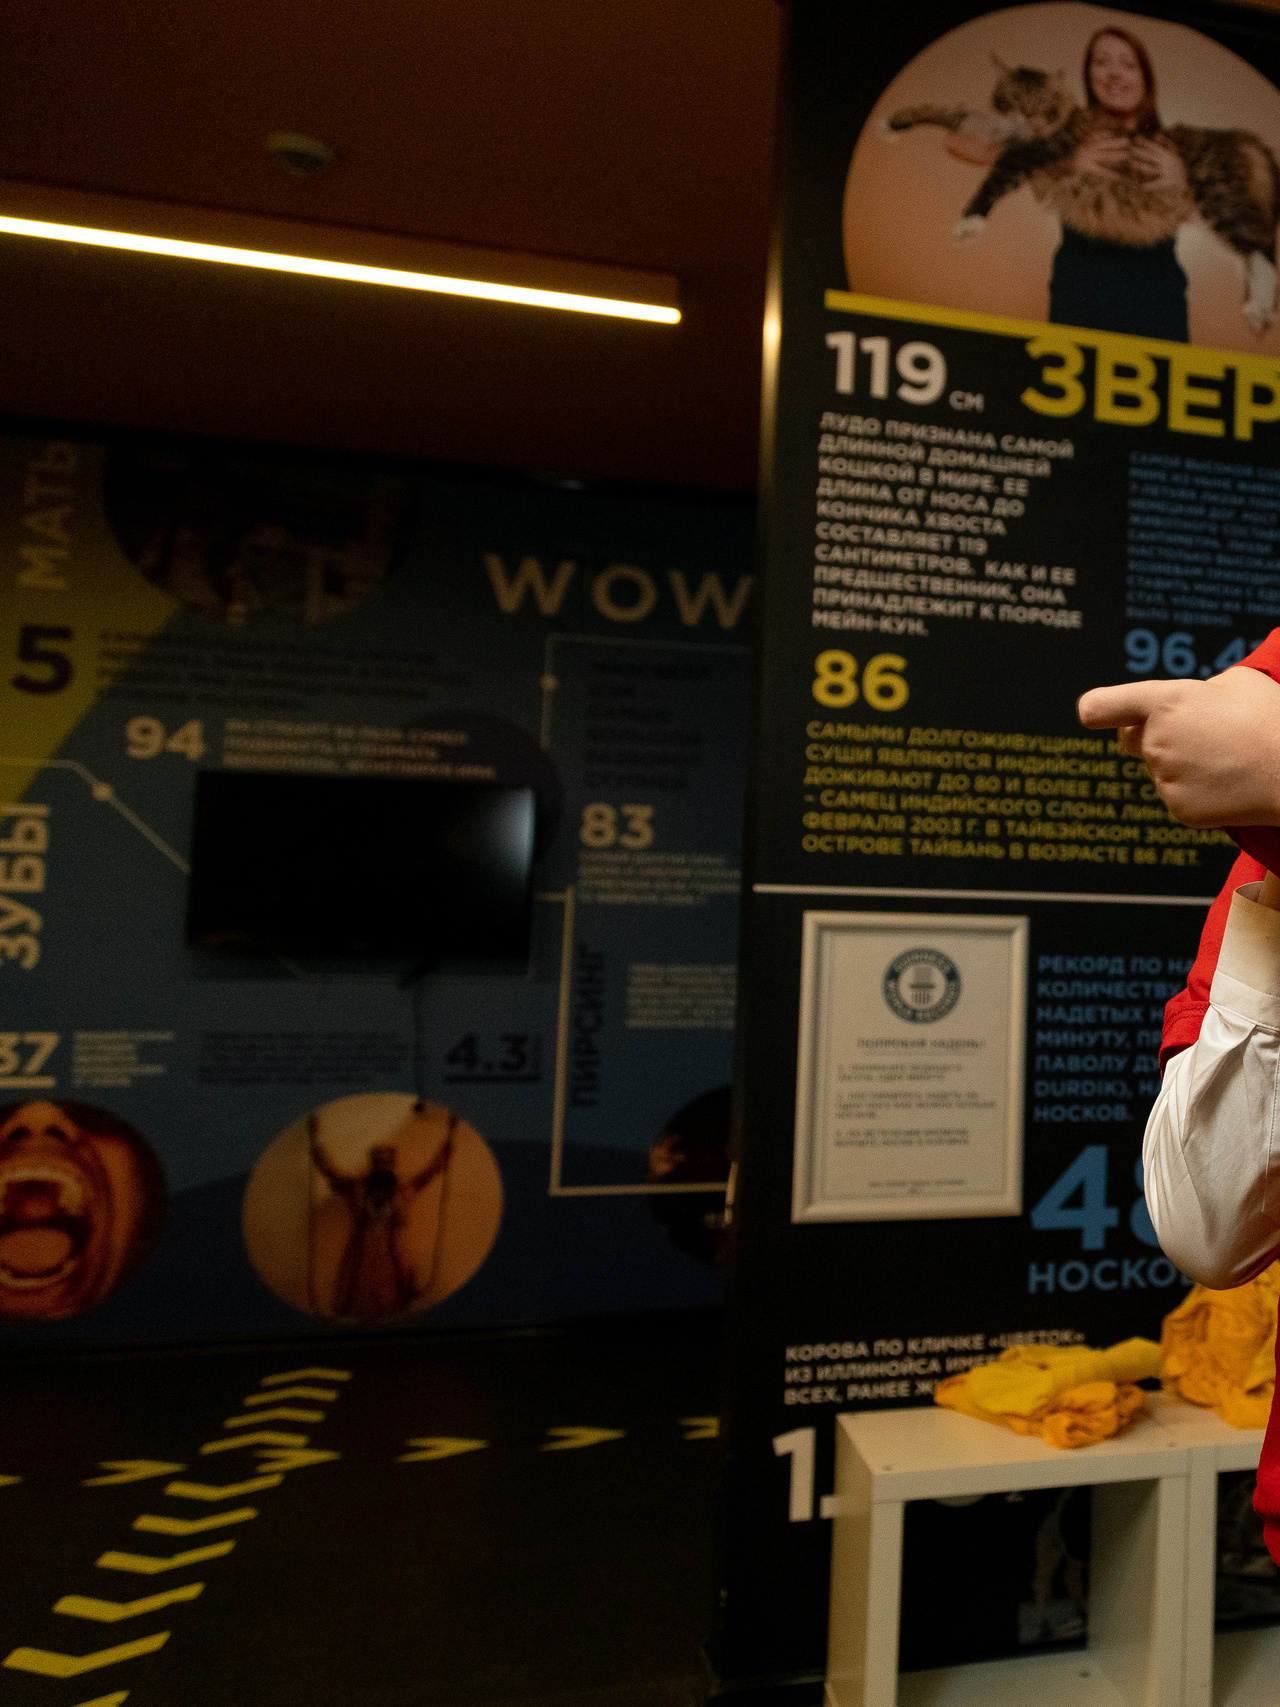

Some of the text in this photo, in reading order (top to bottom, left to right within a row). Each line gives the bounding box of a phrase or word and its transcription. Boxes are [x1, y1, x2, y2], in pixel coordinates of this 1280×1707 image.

[825, 330, 948, 406] 119
[818, 433, 1052, 477] ДЛИННОЙ ДОМАШНЕЙ
[885, 420, 997, 450] ПРИЗНАНА
[1000, 434, 1075, 459] САМОЙ
[818, 456, 916, 482] КОШКОЙ
[919, 467, 934, 485] В
[1003, 477, 1029, 497] ЕЕ
[816, 477, 1026, 518] ДЛИНА ОТ НОСА ДО
[816, 501, 1007, 536] КОНЧИКА ХВОСТА
[815, 520, 988, 556] СОСТАВЛЯЕТ 119
[814, 543, 1077, 587] САНТИМЕТРОВ. КАК И ЕЕ
[812, 587, 1083, 630] ПРИНАДЛЕЖИТ К ПОРОДЕ
[1021, 585, 1067, 606] ОНА
[12, 624, 73, 695] 5
[1124, 627, 1267, 678] 96.4
[811, 649, 909, 712] 86
[126, 716, 206, 760] 94
[806, 720, 904, 743] САМЫМИ
[907, 726, 1104, 755] ДОЛГОЖИВУЩИМИ
[805, 743, 873, 765] СУШИ
[877, 747, 992, 771] ЯВЛЯЮТСЯ
[995, 753, 1118, 778] ИНДИЙСКИЕ
[803, 765, 934, 790] ДОЖИВАЮТ
[937, 773, 970, 792] ДО
[1005, 777, 1021, 793] И
[1024, 779, 1091, 798] БОЛЕЕ
[820, 788, 897, 812] САМЕЦ
[900, 793, 1042, 818] ИНДИЙСКОГО
[1045, 801, 1117, 820] СЛОНА
[579, 802, 654, 849] 83
[802, 811, 906, 833] ФЕВРАЛЯ
[910, 816, 962, 836] 2003
[984, 819, 1000, 837] В
[801, 833, 903, 856] ОСТРОВЕ
[909, 837, 1006, 860] ТАЙВАНЬ
[1009, 842, 1024, 860] В
[1027, 842, 1129, 864] ВОЗРАСТЕ
[1037, 955, 1196, 977] РЕКОРД ПО НА
[1036, 980, 1183, 1000] КОЛИЧЕСТВУ
[1036, 1004, 1145, 1025] НАДЕТЫХ
[1035, 1029, 1131, 1049] МИНУТУ,
[1034, 1054, 1129, 1074] ПАВОЛУ
[1027, 1256, 1194, 1295] НОСКО
[784, 1340, 869, 1363] КОРОВА
[873, 1338, 904, 1358] ПО
[907, 1333, 986, 1355] КЛИЧКЕ
[784, 1366, 812, 1384] ИЗ
[816, 1357, 942, 1382] ИЛЛИНОЙСА
[783, 1384, 844, 1406] ВСЕХ,
[847, 1380, 912, 1401] РАНЕЕ
